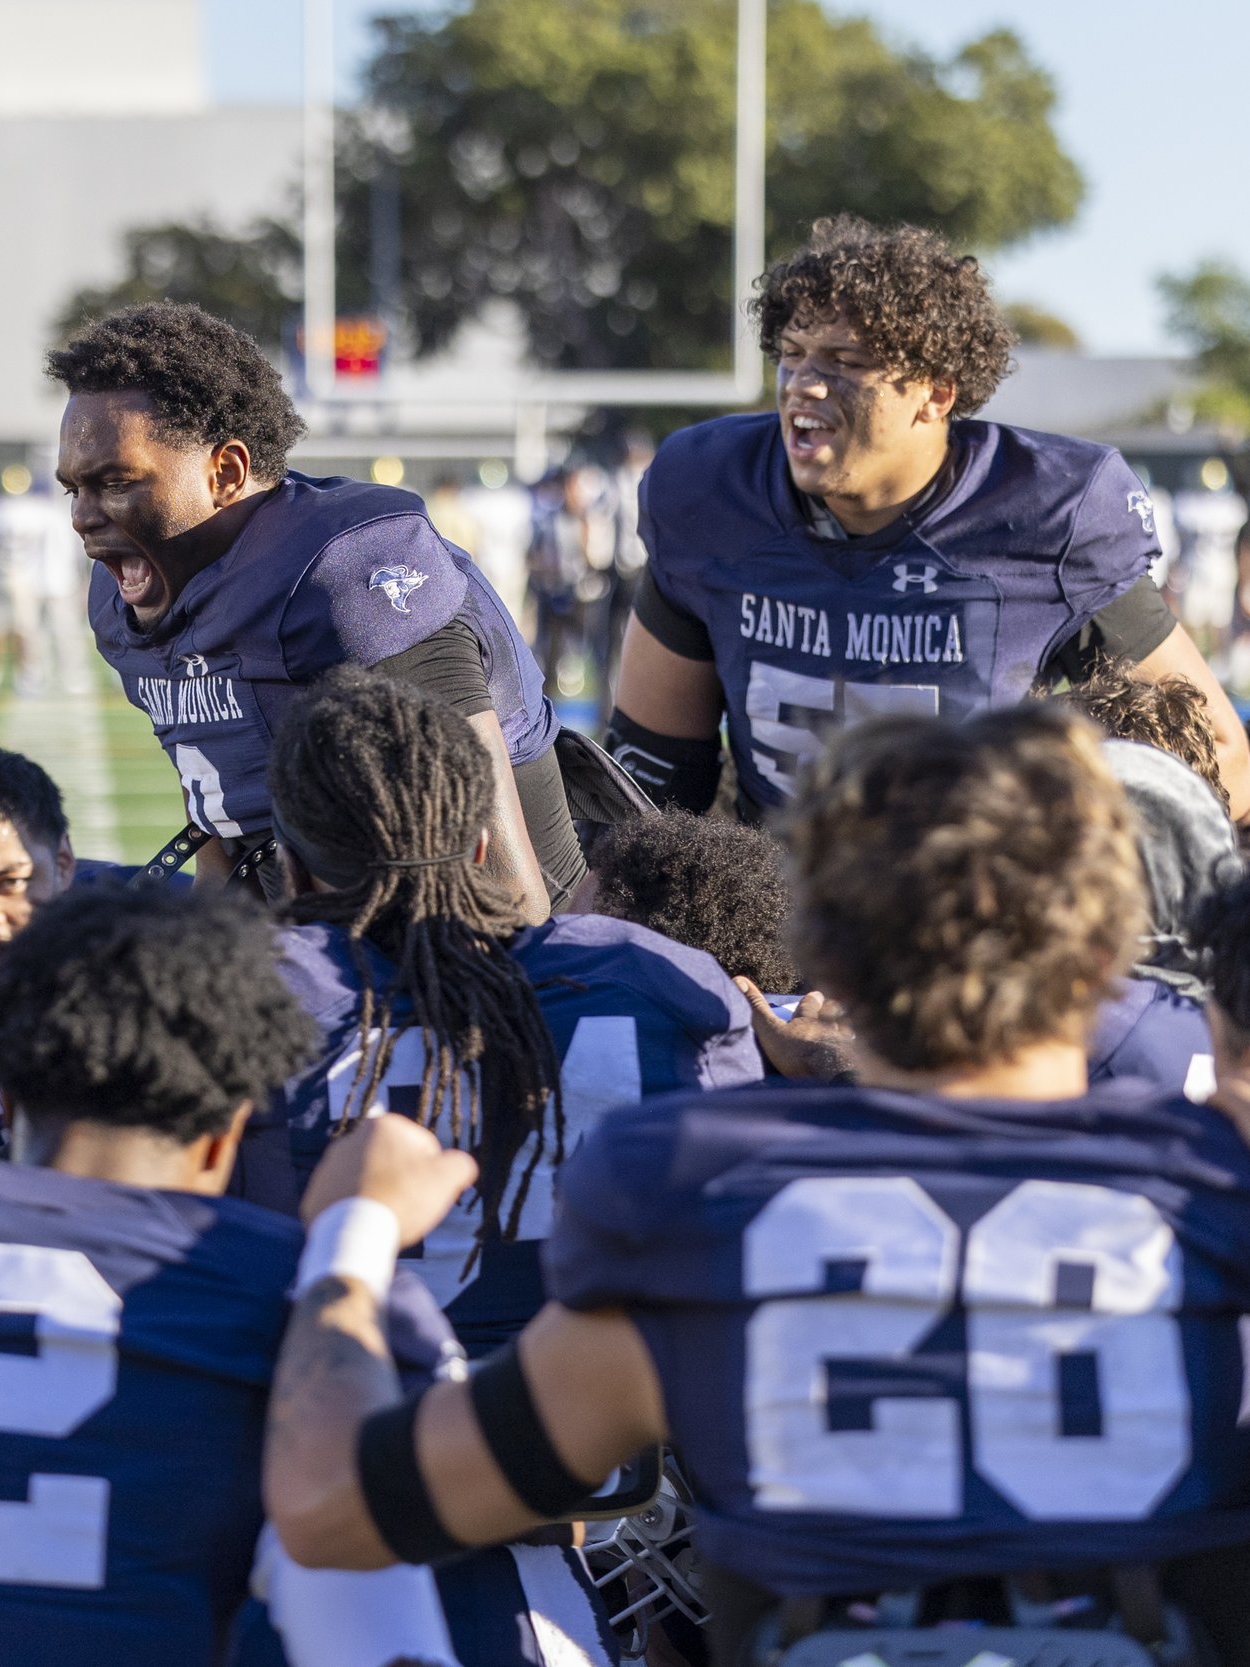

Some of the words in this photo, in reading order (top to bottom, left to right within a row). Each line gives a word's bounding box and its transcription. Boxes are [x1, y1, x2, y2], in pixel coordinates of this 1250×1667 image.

[740, 593, 832, 657] SANTA
[845, 613, 963, 664] MONICA
[138, 677, 174, 725] SANTA
[177, 676, 244, 725] MONICA
[743, 1176, 1192, 1522] 28
